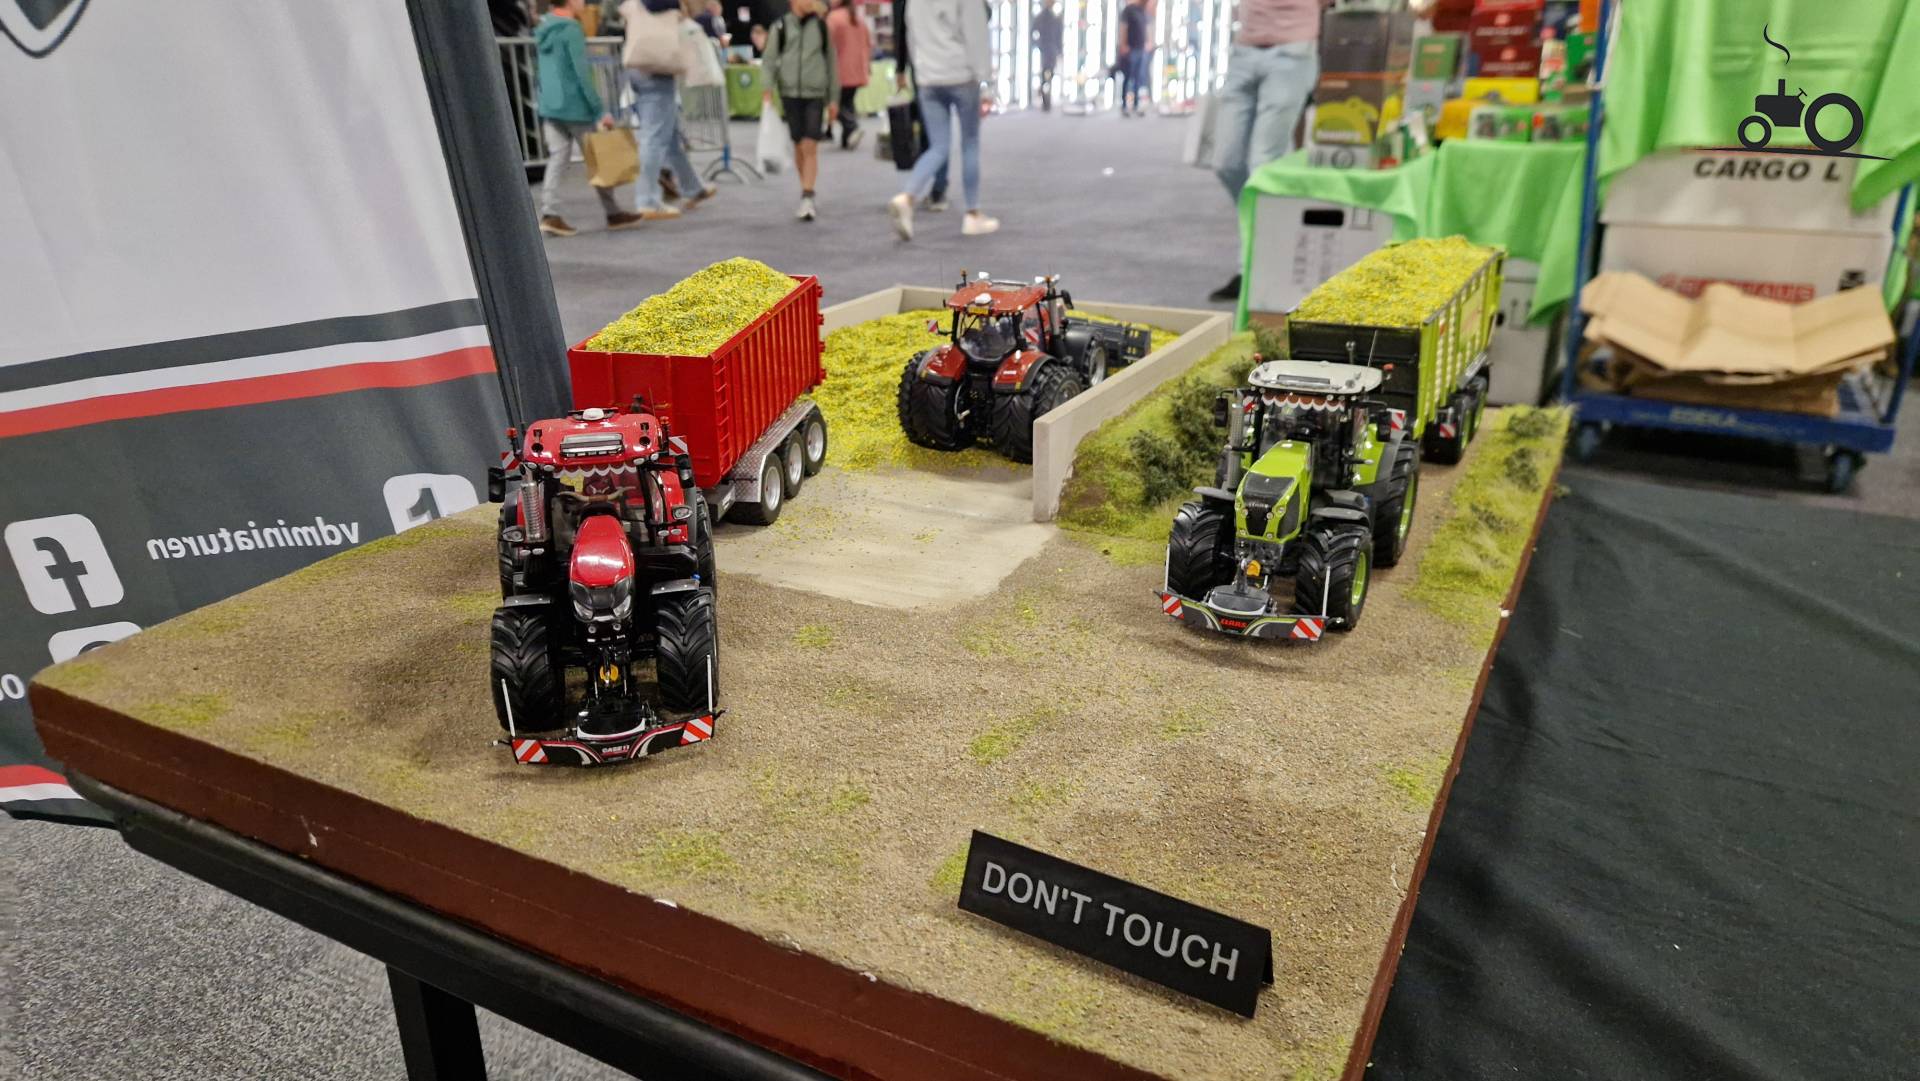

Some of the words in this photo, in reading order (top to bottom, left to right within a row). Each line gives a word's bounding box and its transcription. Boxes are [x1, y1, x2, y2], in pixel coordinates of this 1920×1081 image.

[1694, 158, 1811, 182] CARGO
[1823, 160, 1843, 182] L
[1220, 618, 1248, 628] CLAAS
[982, 861, 1093, 925] DON'T
[1102, 902, 1239, 981] TOUCH
